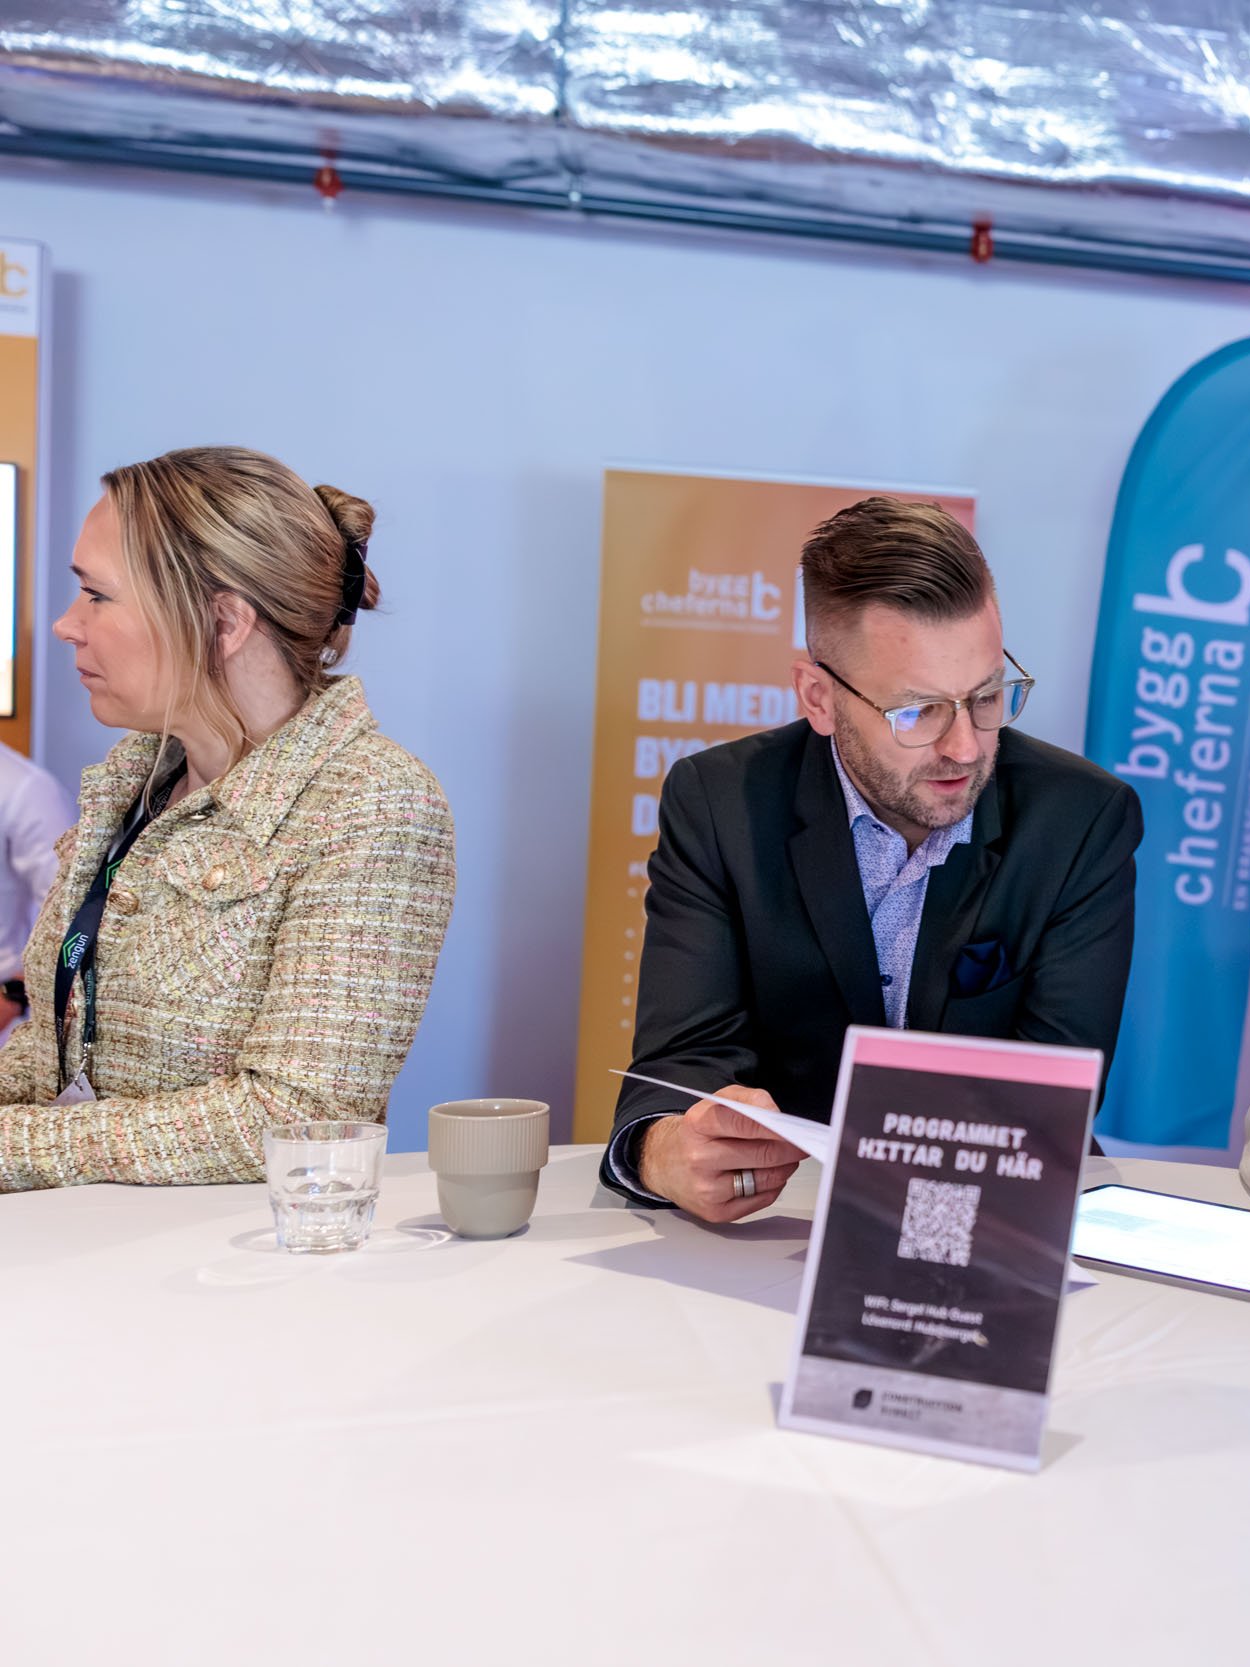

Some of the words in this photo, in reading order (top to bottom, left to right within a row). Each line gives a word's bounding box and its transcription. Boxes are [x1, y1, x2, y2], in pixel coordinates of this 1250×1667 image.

[637, 678, 697, 724] BLI
[1114, 626, 1195, 778] bygg
[1166, 639, 1246, 905] cheferna
[67, 934, 89, 969] zengun
[883, 1112, 1027, 1149] PROGRAMMET
[856, 1137, 944, 1168] HITTAR
[954, 1149, 988, 1173] DU
[996, 1151, 1044, 1181] HÄR
